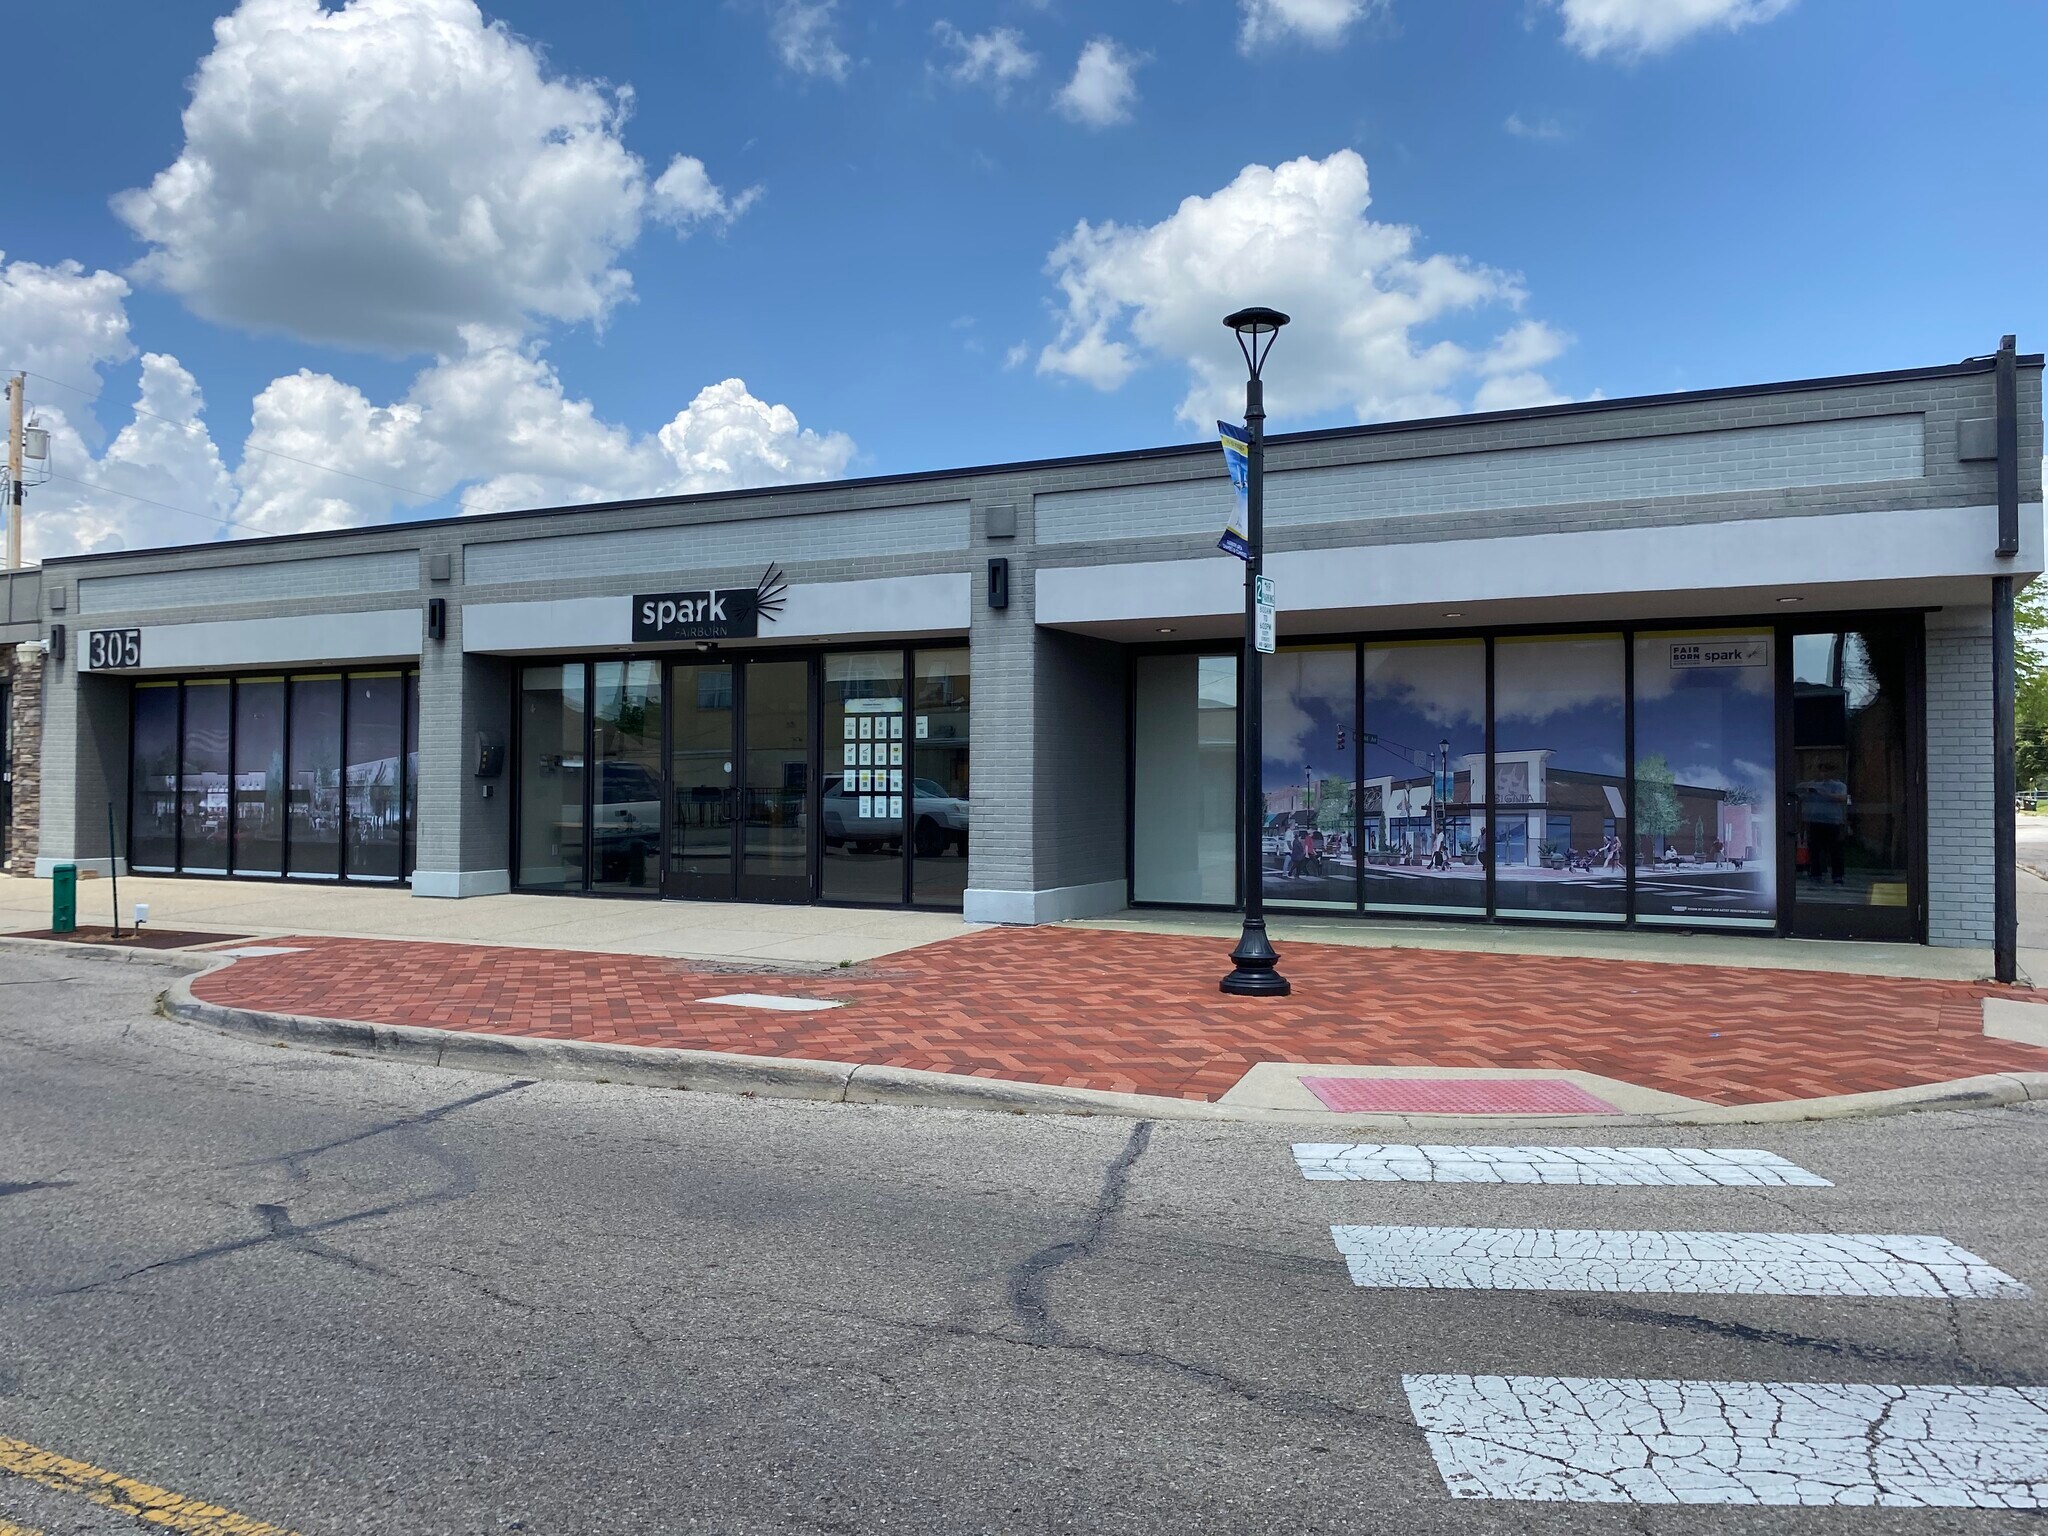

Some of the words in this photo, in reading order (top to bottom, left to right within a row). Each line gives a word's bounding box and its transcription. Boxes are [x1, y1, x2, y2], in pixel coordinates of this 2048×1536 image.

[1257, 581, 1262, 600] 2
[642, 590, 727, 632] spark
[675, 626, 728, 638] FAIRBORN
[91, 630, 139, 668] 305
[1673, 646, 1700, 654] FAIR
[1704, 649, 1743, 662] spark
[1481, 793, 1535, 803] ISIGNIA
